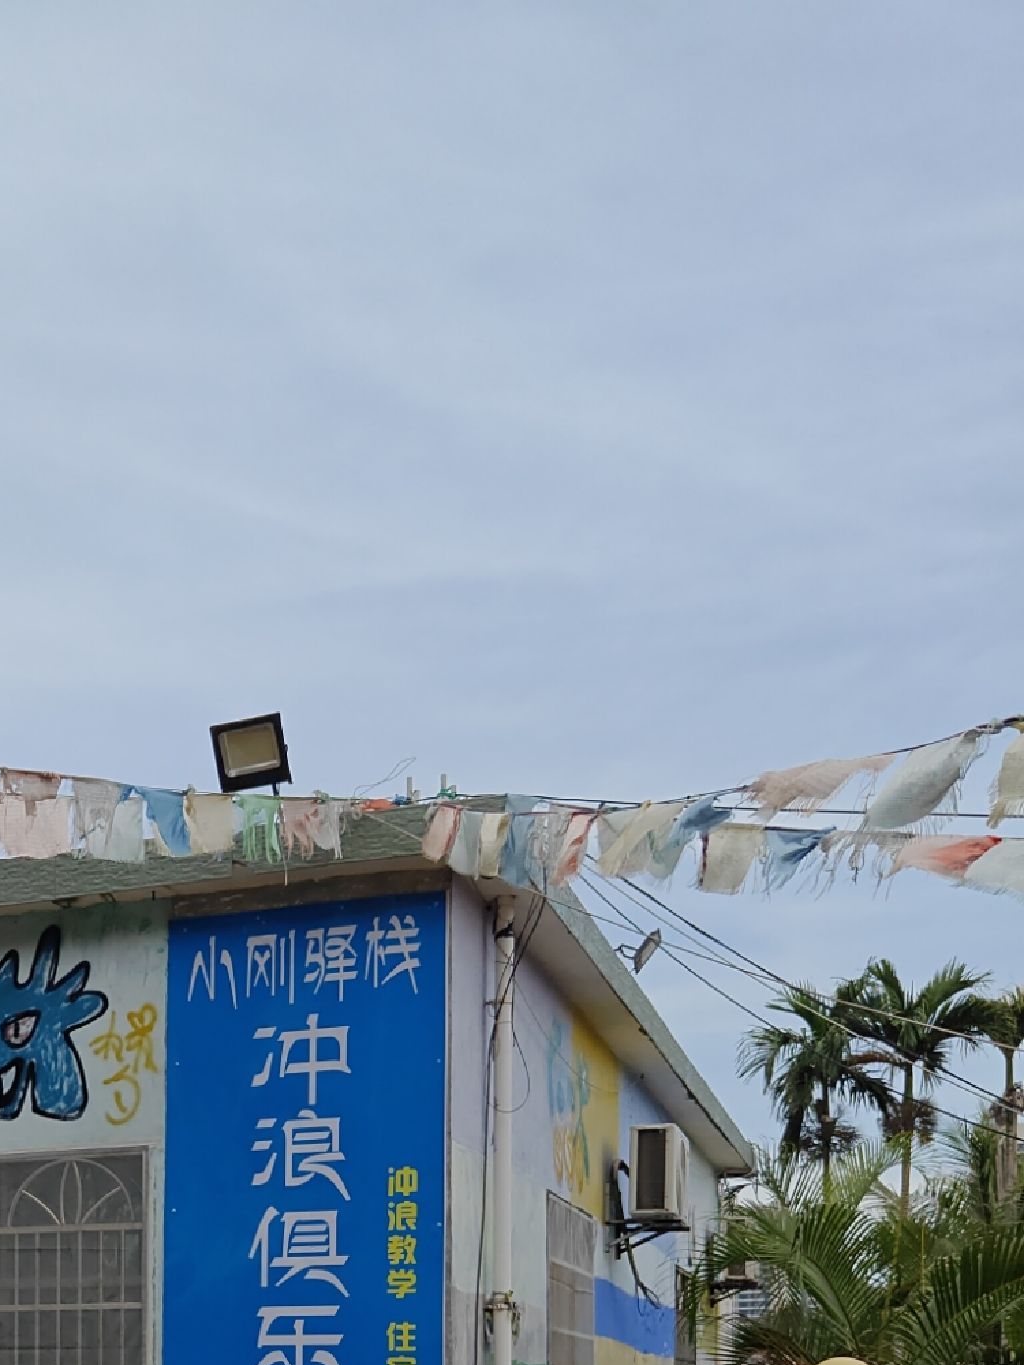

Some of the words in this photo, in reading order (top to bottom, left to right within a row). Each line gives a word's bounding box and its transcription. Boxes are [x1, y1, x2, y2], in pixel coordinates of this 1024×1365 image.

[187, 914, 421, 1009] 小刚驿栈
[387, 1166, 419, 1299] 冲浪教学
